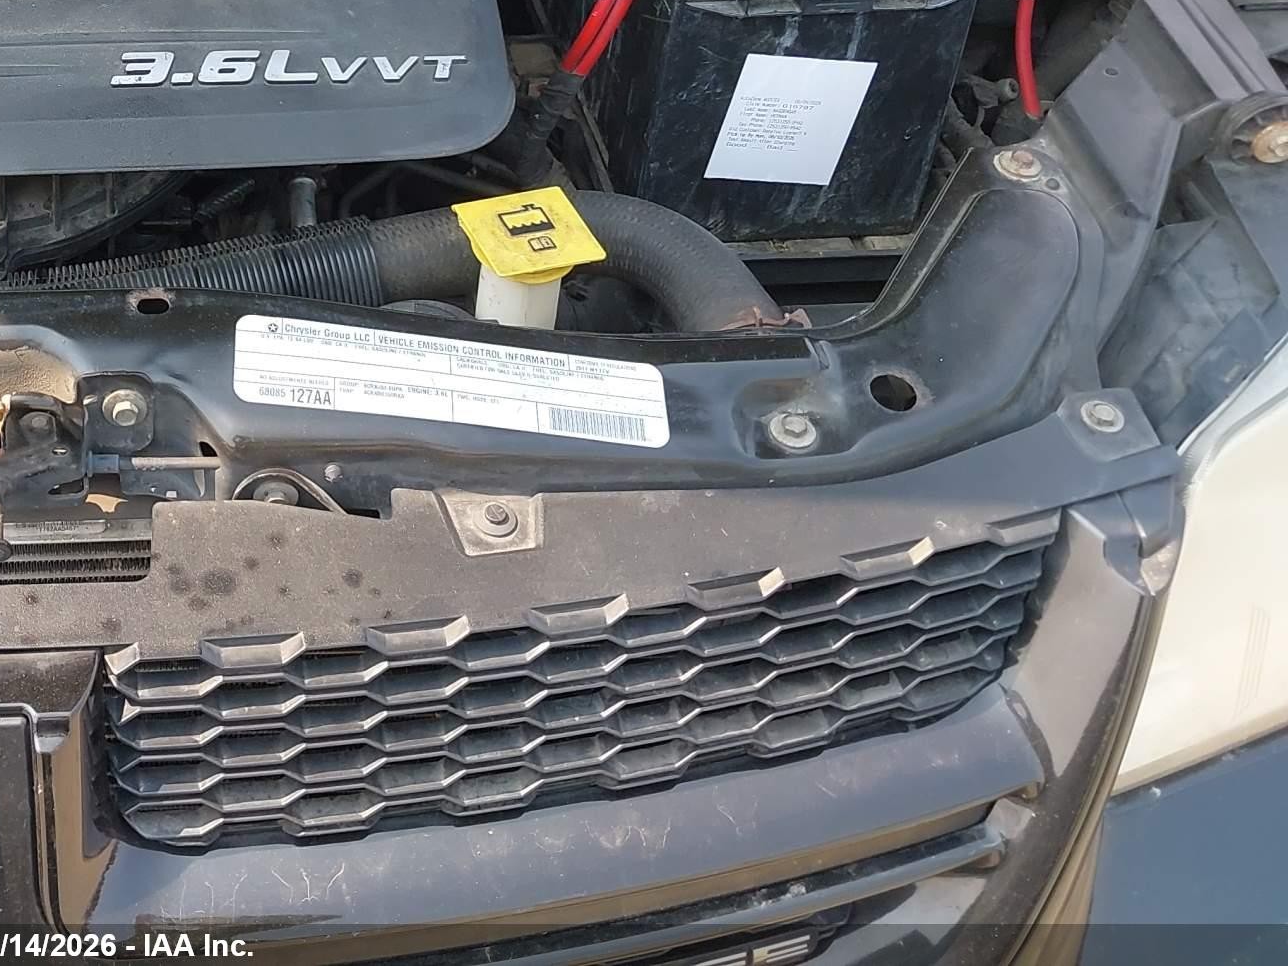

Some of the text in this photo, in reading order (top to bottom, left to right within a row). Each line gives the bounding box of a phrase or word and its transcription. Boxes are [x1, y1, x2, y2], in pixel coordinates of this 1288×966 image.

[110, 49, 471, 87] 3.6L VVT
[284, 323, 323, 337] Chrysler
[324, 328, 351, 341] Group
[353, 332, 370, 343] LLC
[378, 335, 415, 348] VEHICLE
[417, 340, 460, 354] EMISSION
[461, 347, 503, 360] CONTROL
[504, 352, 566, 368] INFORMATION
[290, 387, 332, 406] 127AA
